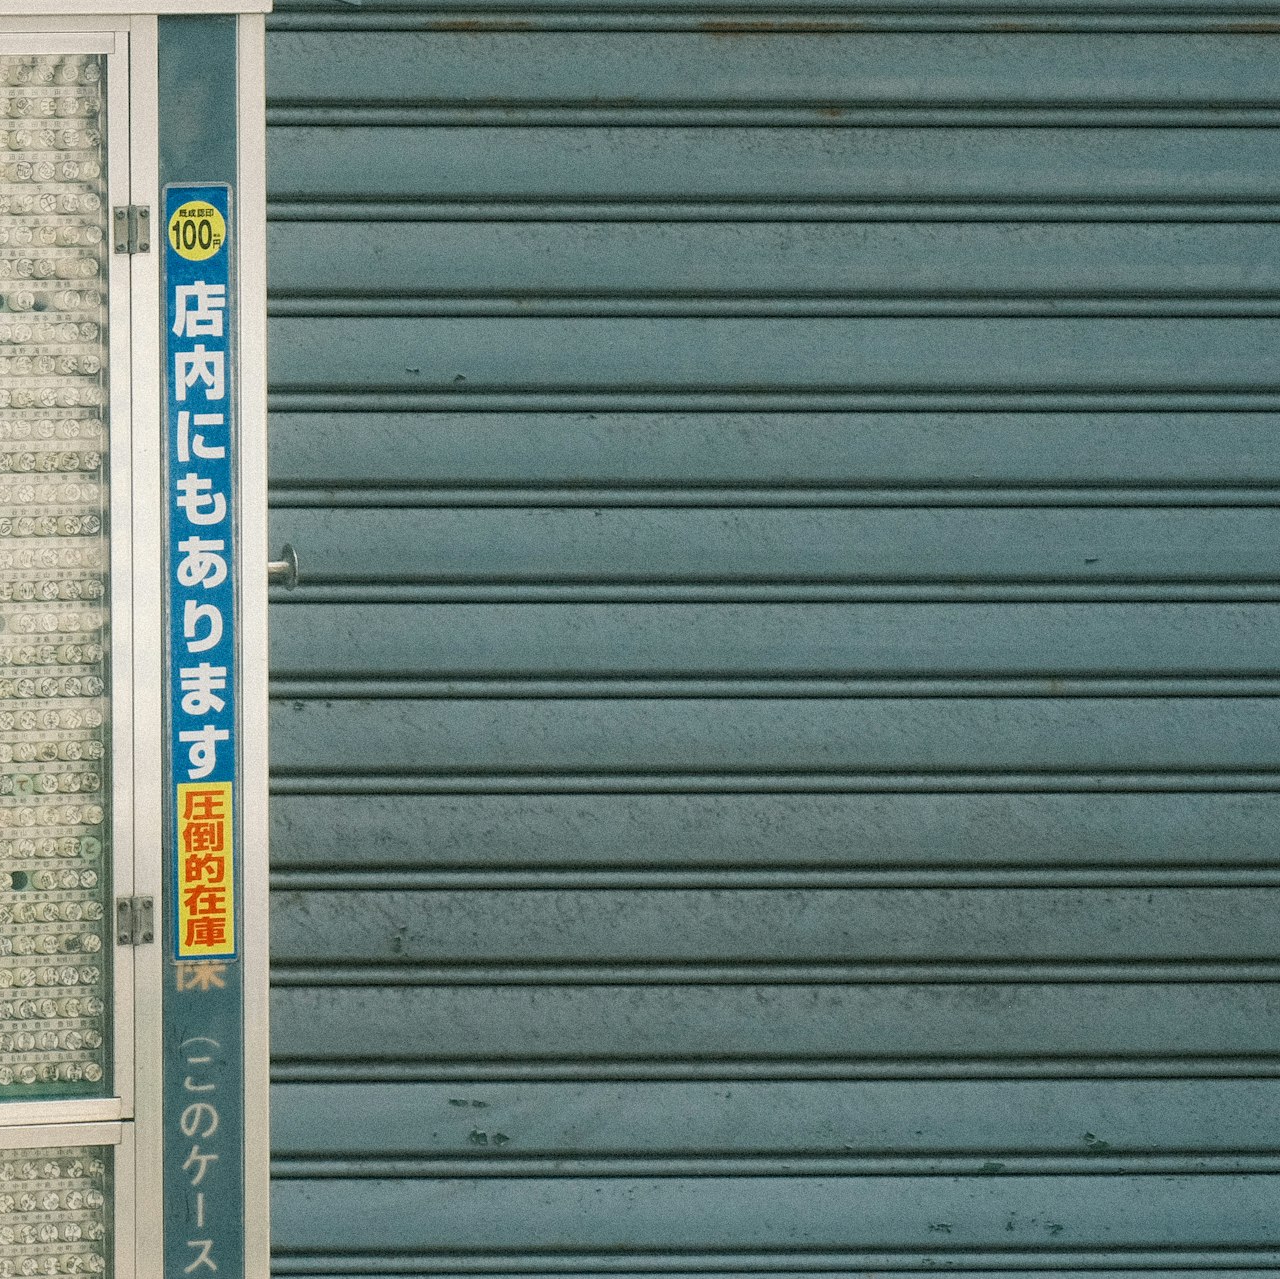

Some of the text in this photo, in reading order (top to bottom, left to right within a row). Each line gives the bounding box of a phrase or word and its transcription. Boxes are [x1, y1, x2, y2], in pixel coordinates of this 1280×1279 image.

[172, 219, 212, 250] 100
[171, 282, 230, 780] 店内にもあります
[182, 790, 226, 947] 圧倒的在庫
